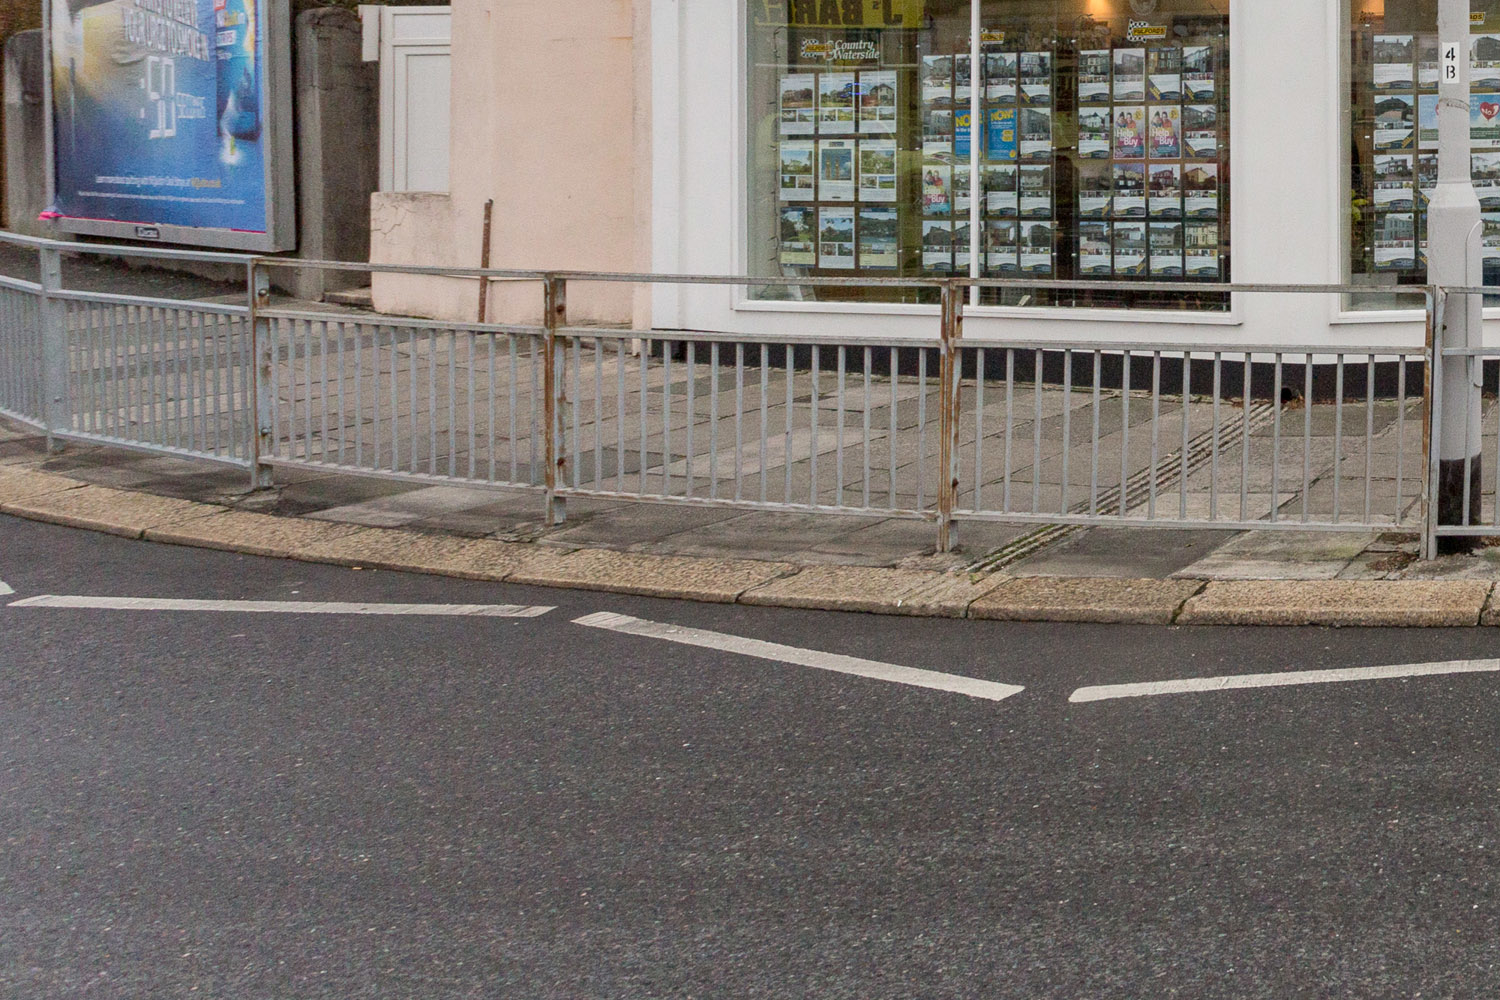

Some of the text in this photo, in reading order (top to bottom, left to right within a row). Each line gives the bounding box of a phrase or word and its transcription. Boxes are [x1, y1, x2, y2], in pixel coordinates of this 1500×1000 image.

[835, 40, 874, 51] Country
[833, 48, 880, 60] Waterside
[1445, 47, 1456, 61] 4
[1446, 65, 1456, 79] B
[1124, 136, 1138, 147] Buy
[1160, 136, 1174, 147] Buy
